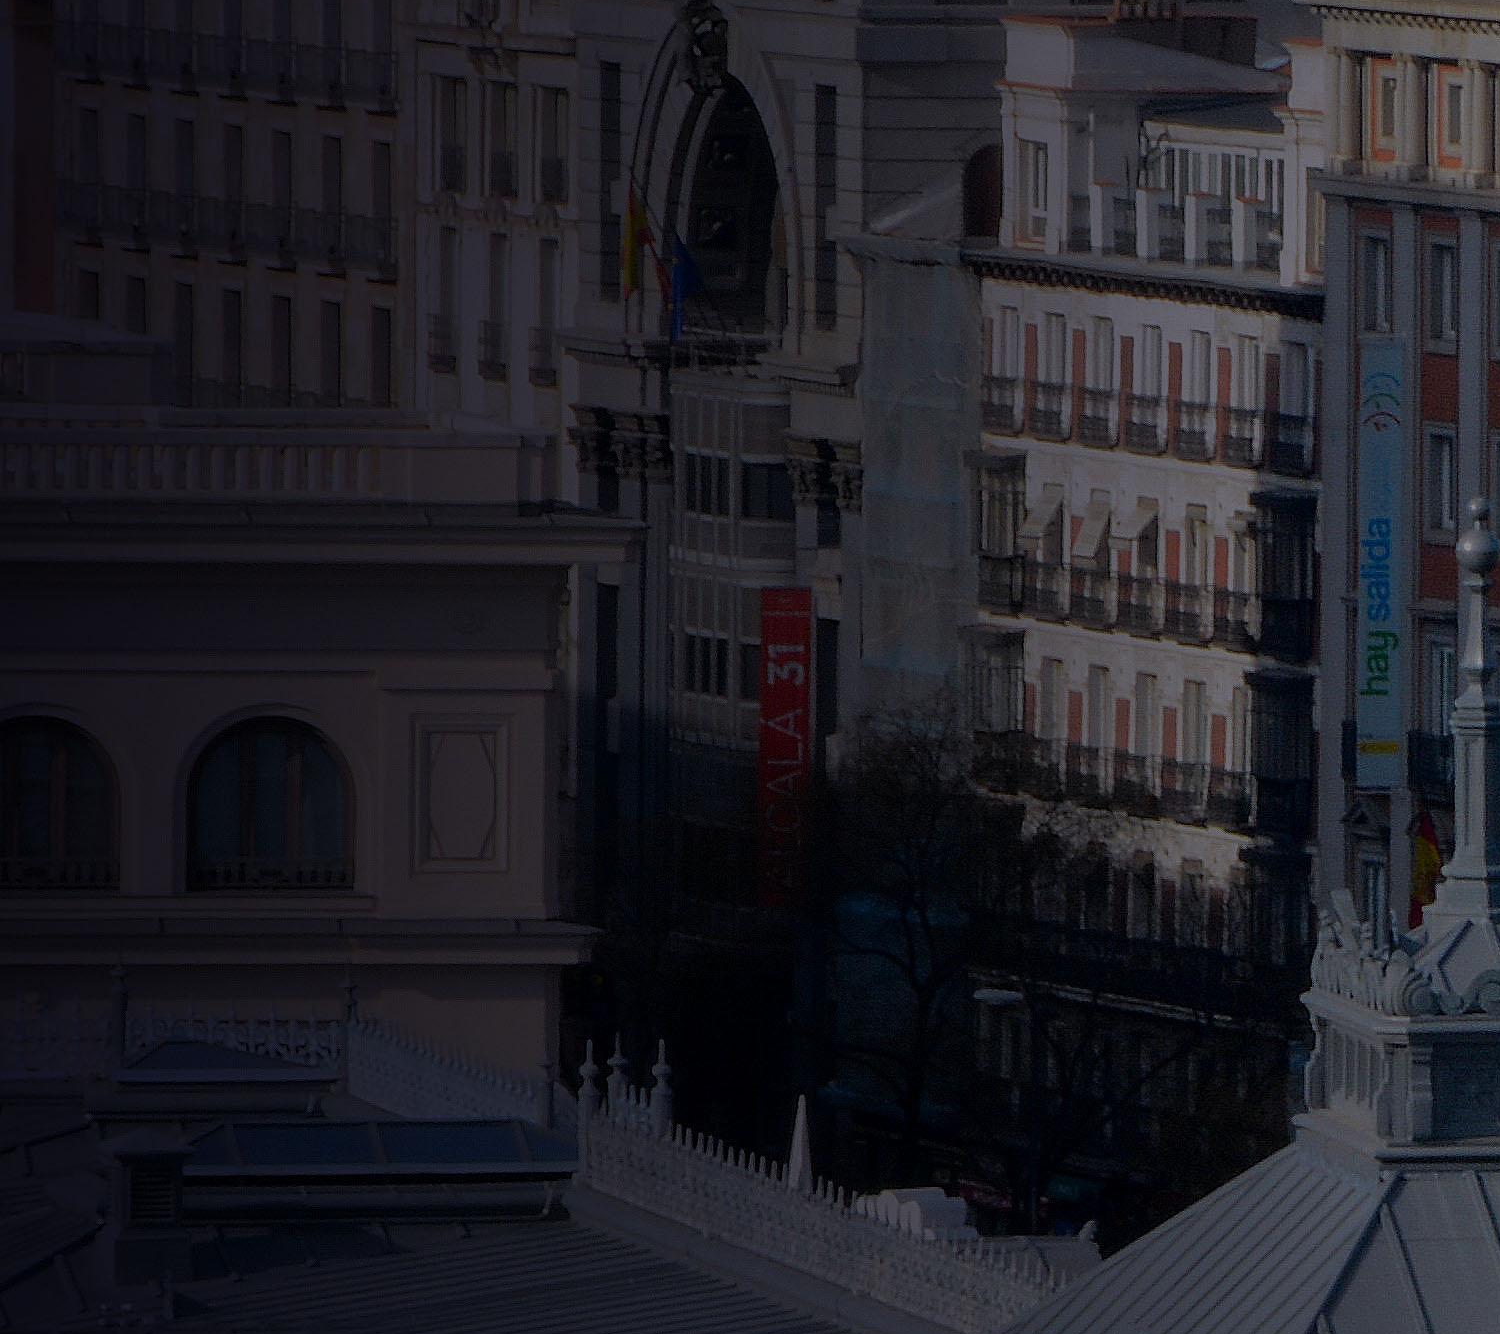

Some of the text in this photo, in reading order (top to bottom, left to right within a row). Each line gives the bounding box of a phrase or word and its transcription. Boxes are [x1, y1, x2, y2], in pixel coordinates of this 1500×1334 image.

[1361, 517, 1392, 622] salida
[768, 643, 804, 686] 31
[1360, 630, 1400, 696] hay
